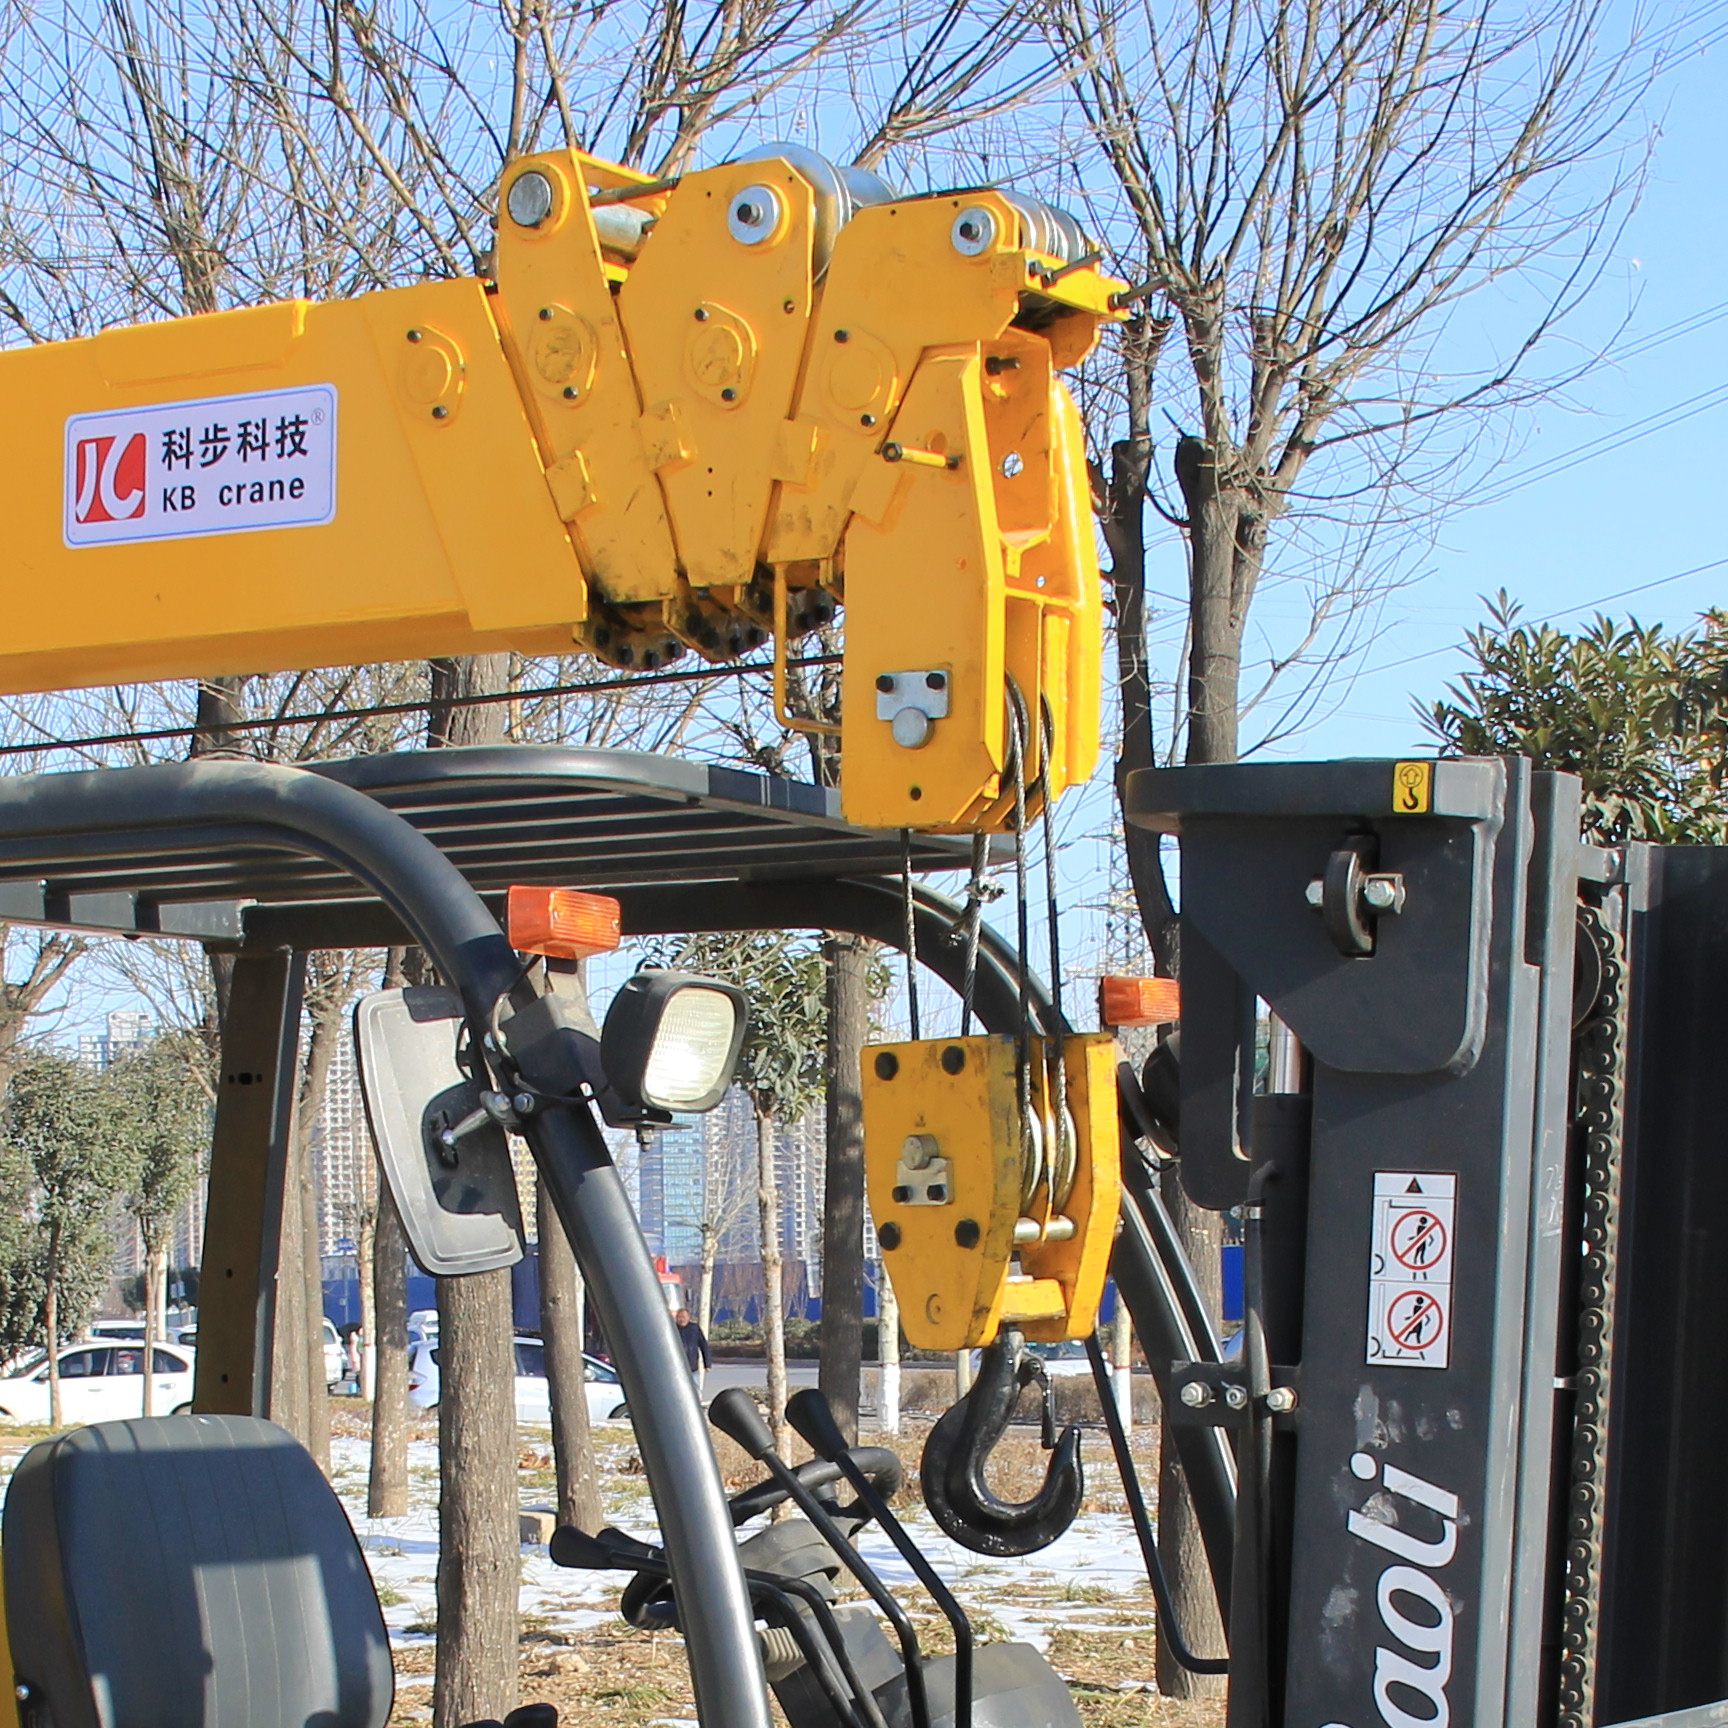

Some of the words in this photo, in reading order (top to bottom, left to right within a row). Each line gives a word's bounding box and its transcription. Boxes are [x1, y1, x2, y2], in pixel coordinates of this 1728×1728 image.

[161, 414, 309, 471] 科步科技
[162, 484, 196, 513] KB
[219, 475, 306, 507] crane
